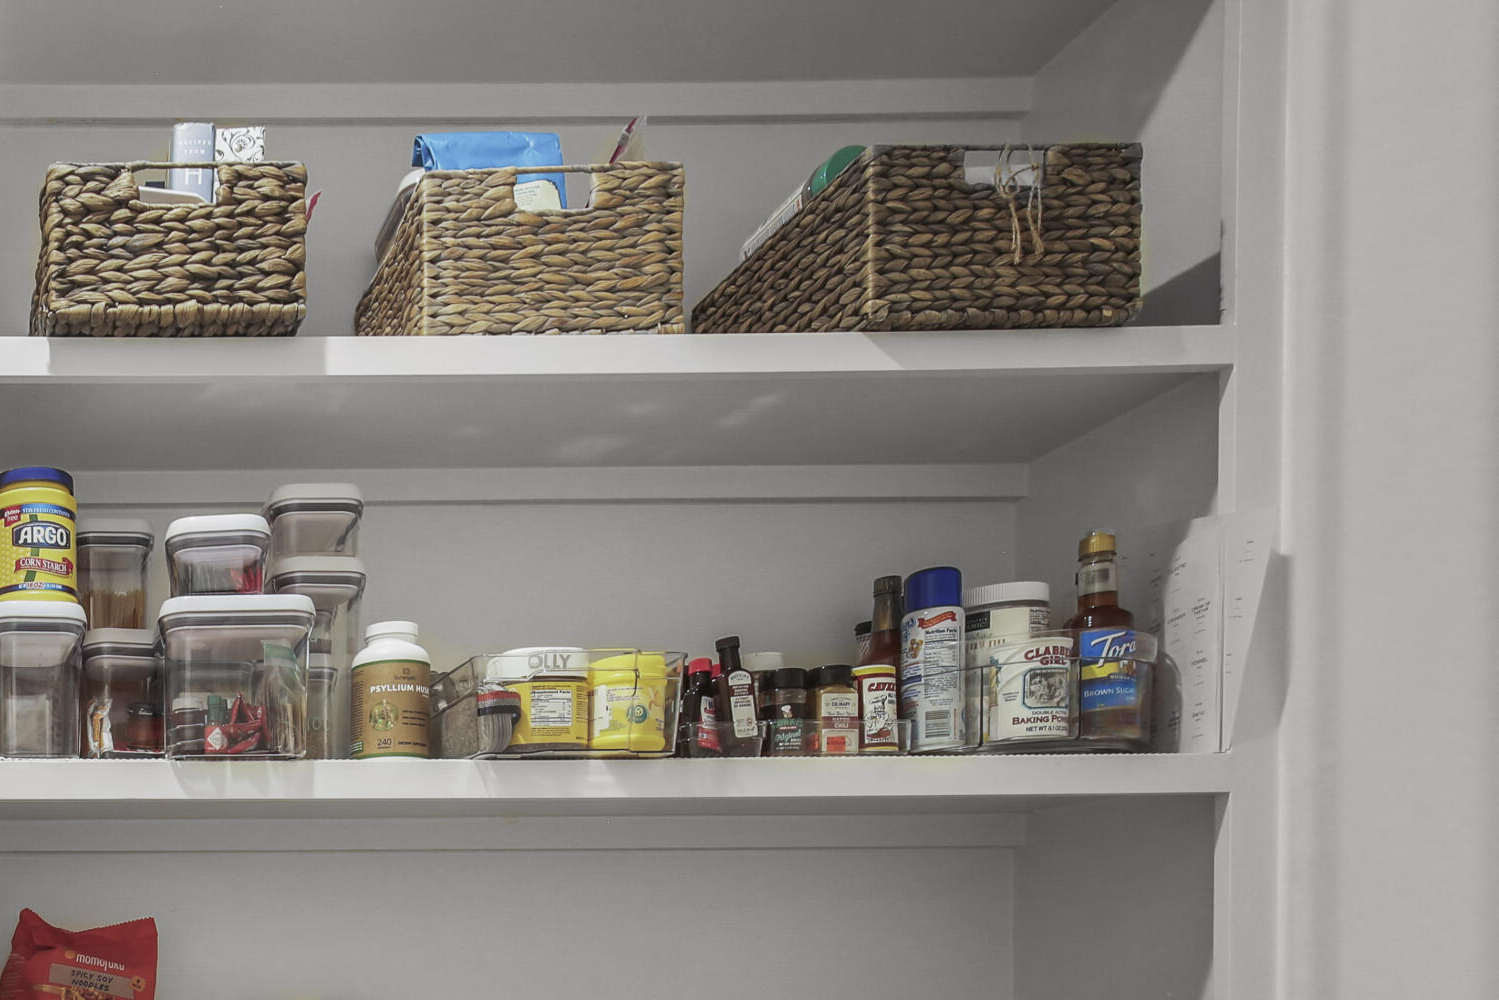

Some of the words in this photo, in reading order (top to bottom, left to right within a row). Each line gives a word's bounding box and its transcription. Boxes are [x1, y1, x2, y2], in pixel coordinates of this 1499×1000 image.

[19, 526, 67, 546] ARGO
[43, 560, 66, 571] STARCH
[528, 653, 572, 669] OLLY
[1040, 656, 1067, 665] GIRL
[370, 684, 414, 694] PSYLLIUM
[377, 738, 392, 747] 240
[76, 953, 125, 971] momofuku
[71, 970, 94, 980] SPICY
[97, 974, 113, 983] SOY
[72, 979, 110, 992] NOODLES
